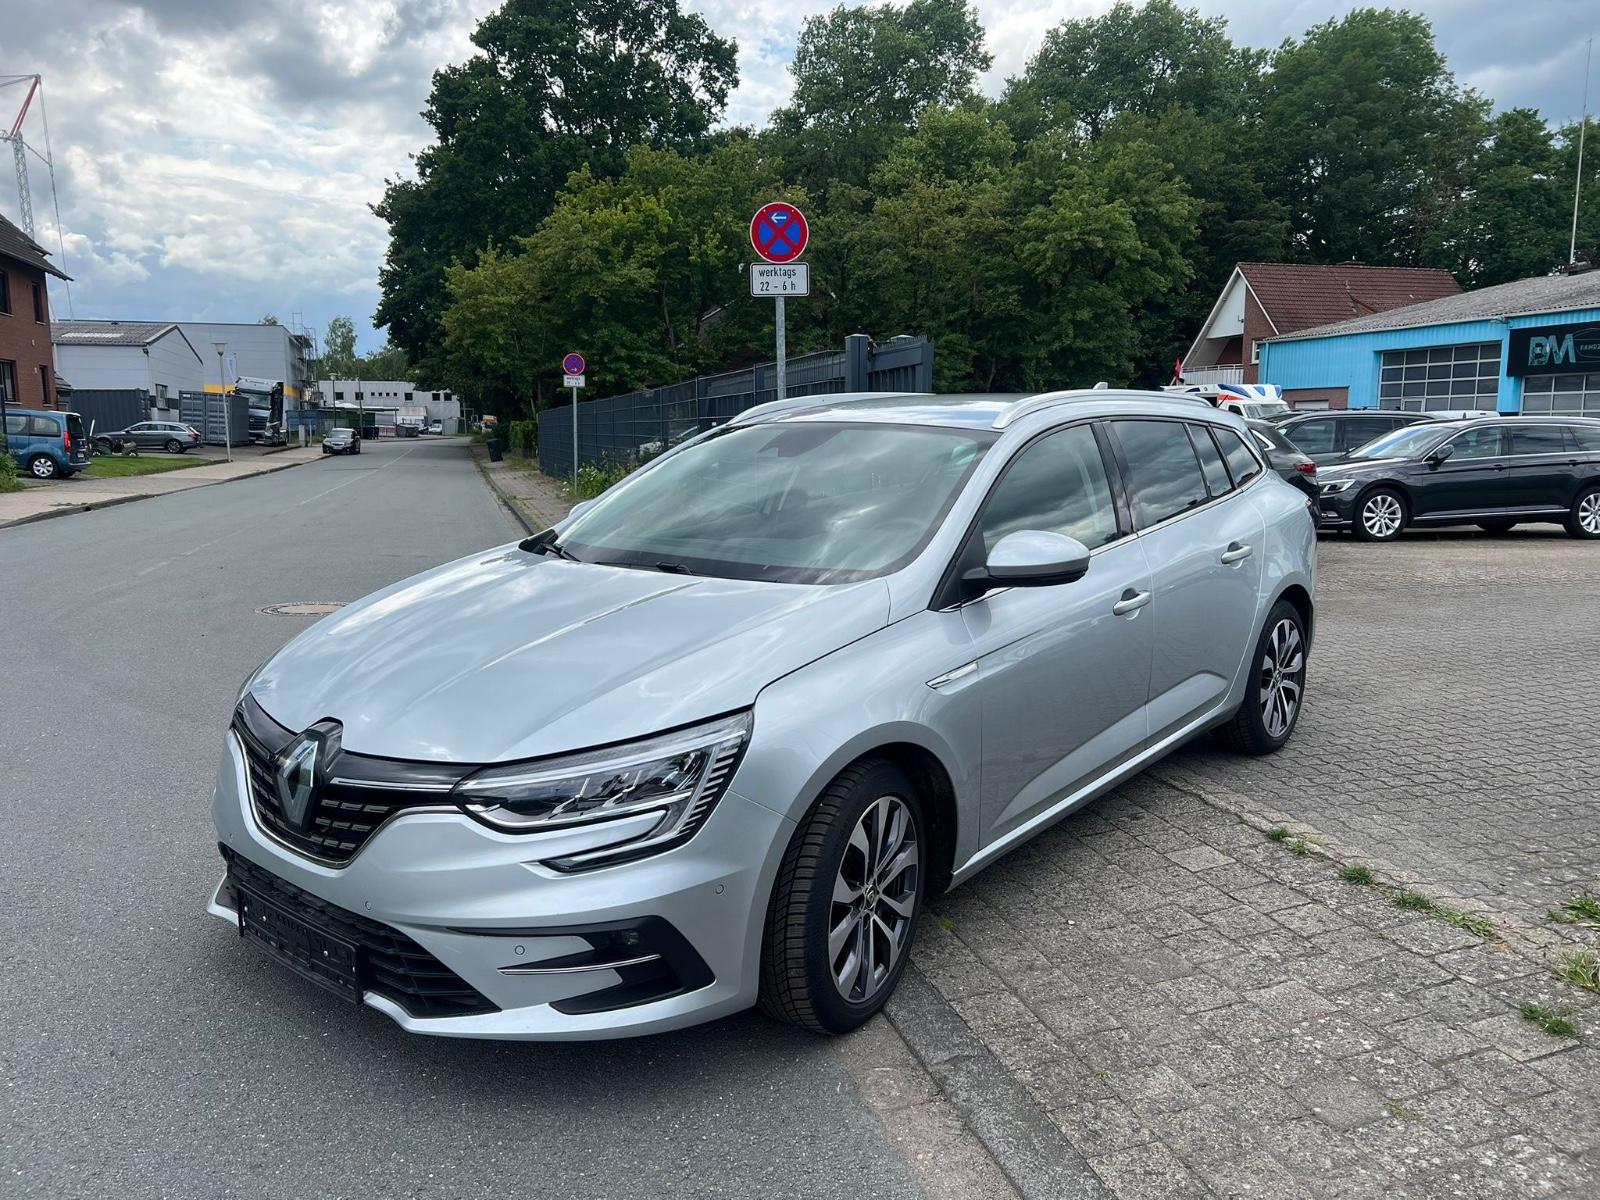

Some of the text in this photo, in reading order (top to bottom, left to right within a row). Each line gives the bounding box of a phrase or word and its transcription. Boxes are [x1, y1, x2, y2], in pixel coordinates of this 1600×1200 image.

[759, 267, 796, 278] werktags
[760, 281, 770, 291] 22
[782, 281, 787, 291] 6
[790, 281, 796, 291] h
[1528, 333, 1576, 366] BM
